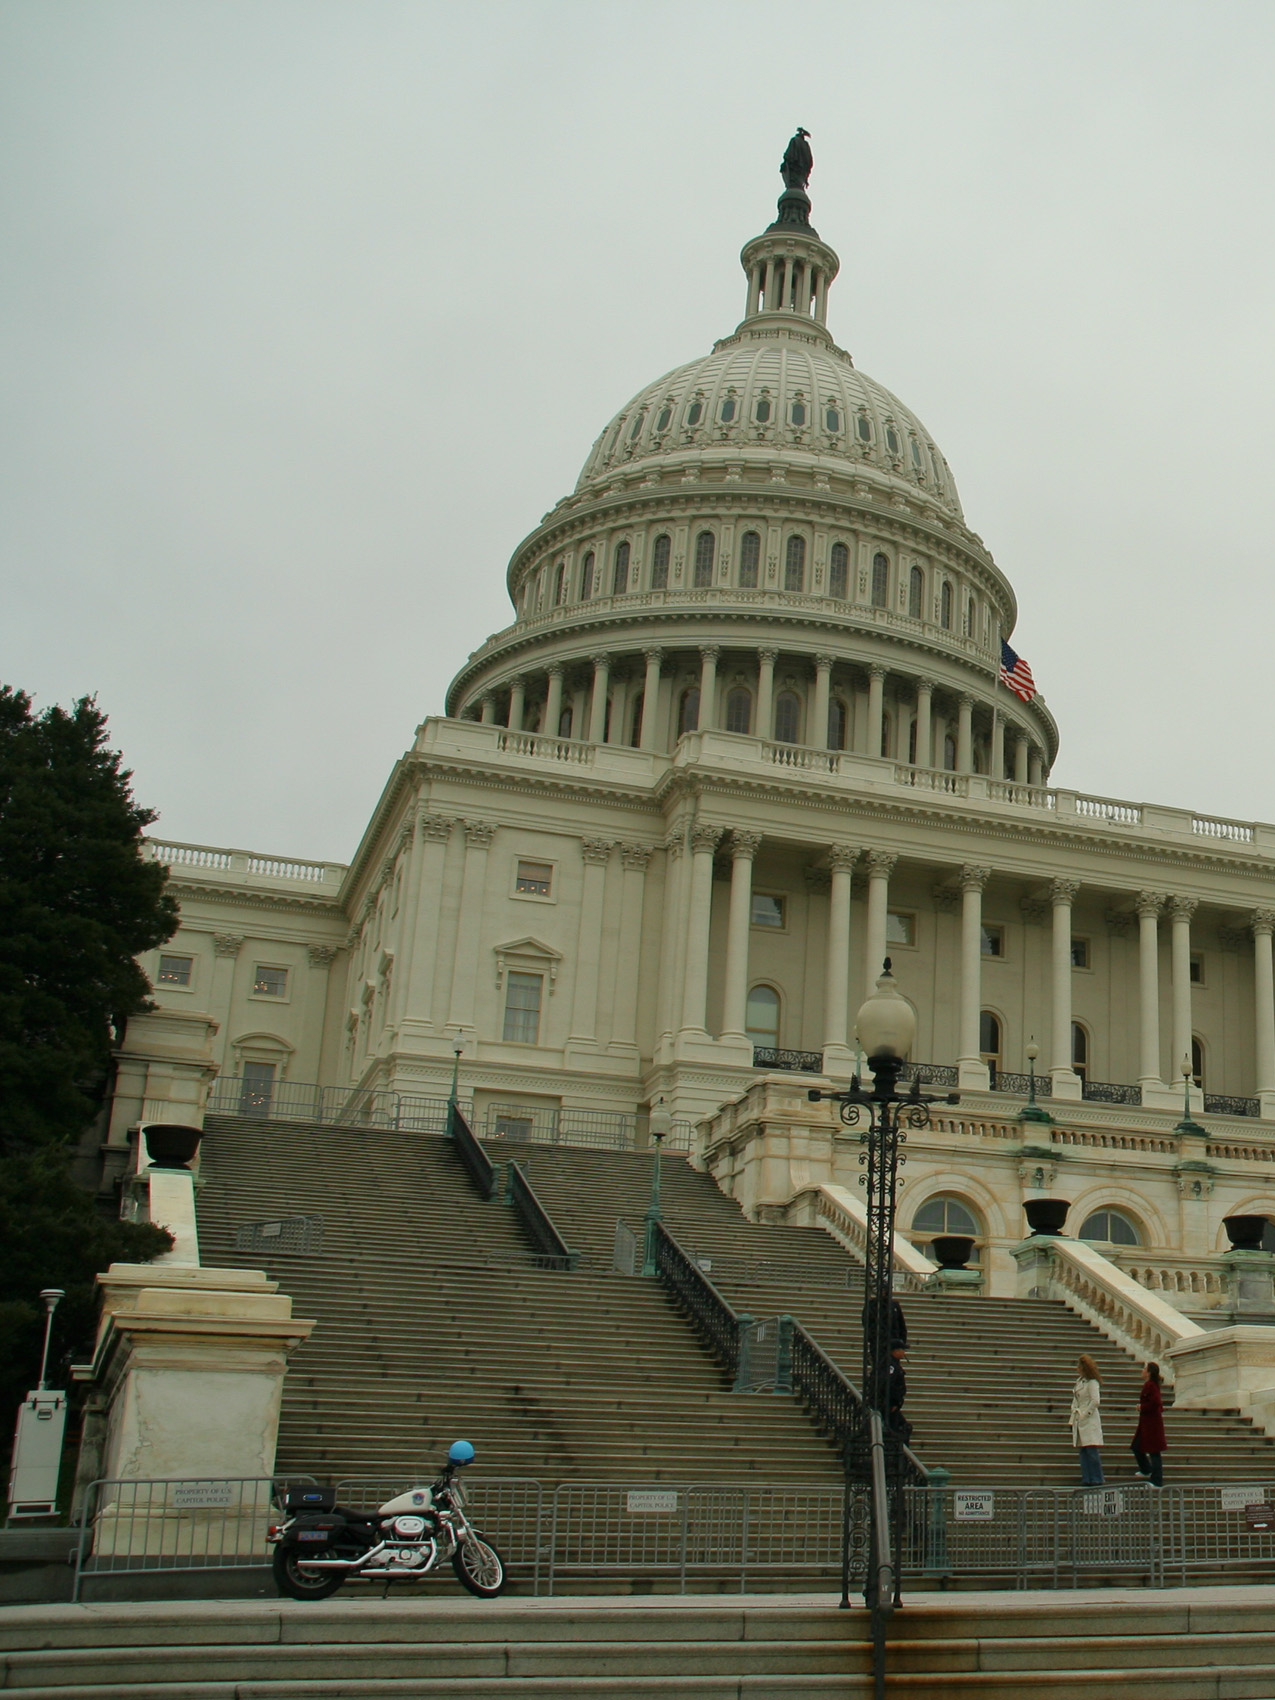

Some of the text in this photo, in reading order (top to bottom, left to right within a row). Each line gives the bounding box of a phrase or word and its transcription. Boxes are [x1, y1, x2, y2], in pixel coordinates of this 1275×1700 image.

[1104, 1491, 1115, 1503] EXIT
[965, 1502, 984, 1510] AREA
[1103, 1503, 1117, 1515] ONLY
